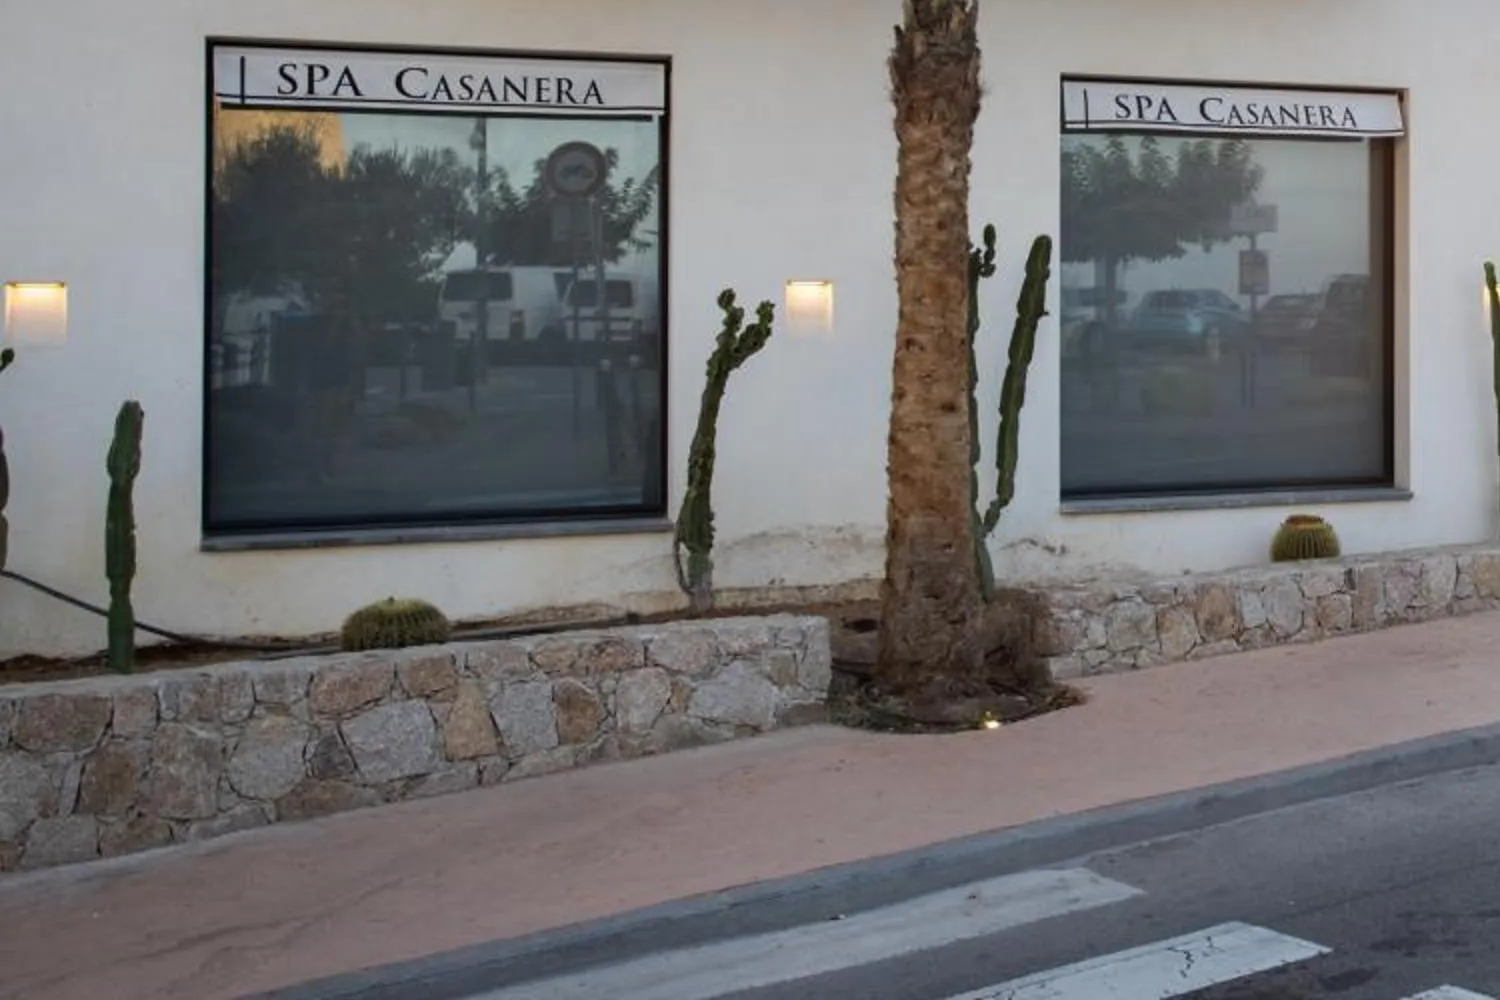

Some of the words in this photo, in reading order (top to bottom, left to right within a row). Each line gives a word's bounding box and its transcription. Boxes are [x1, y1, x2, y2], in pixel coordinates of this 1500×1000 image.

[277, 63, 365, 96] SPA
[395, 67, 604, 105] CASANERA
[1114, 94, 1177, 121] SPA
[1199, 97, 1357, 128] CASANERA
